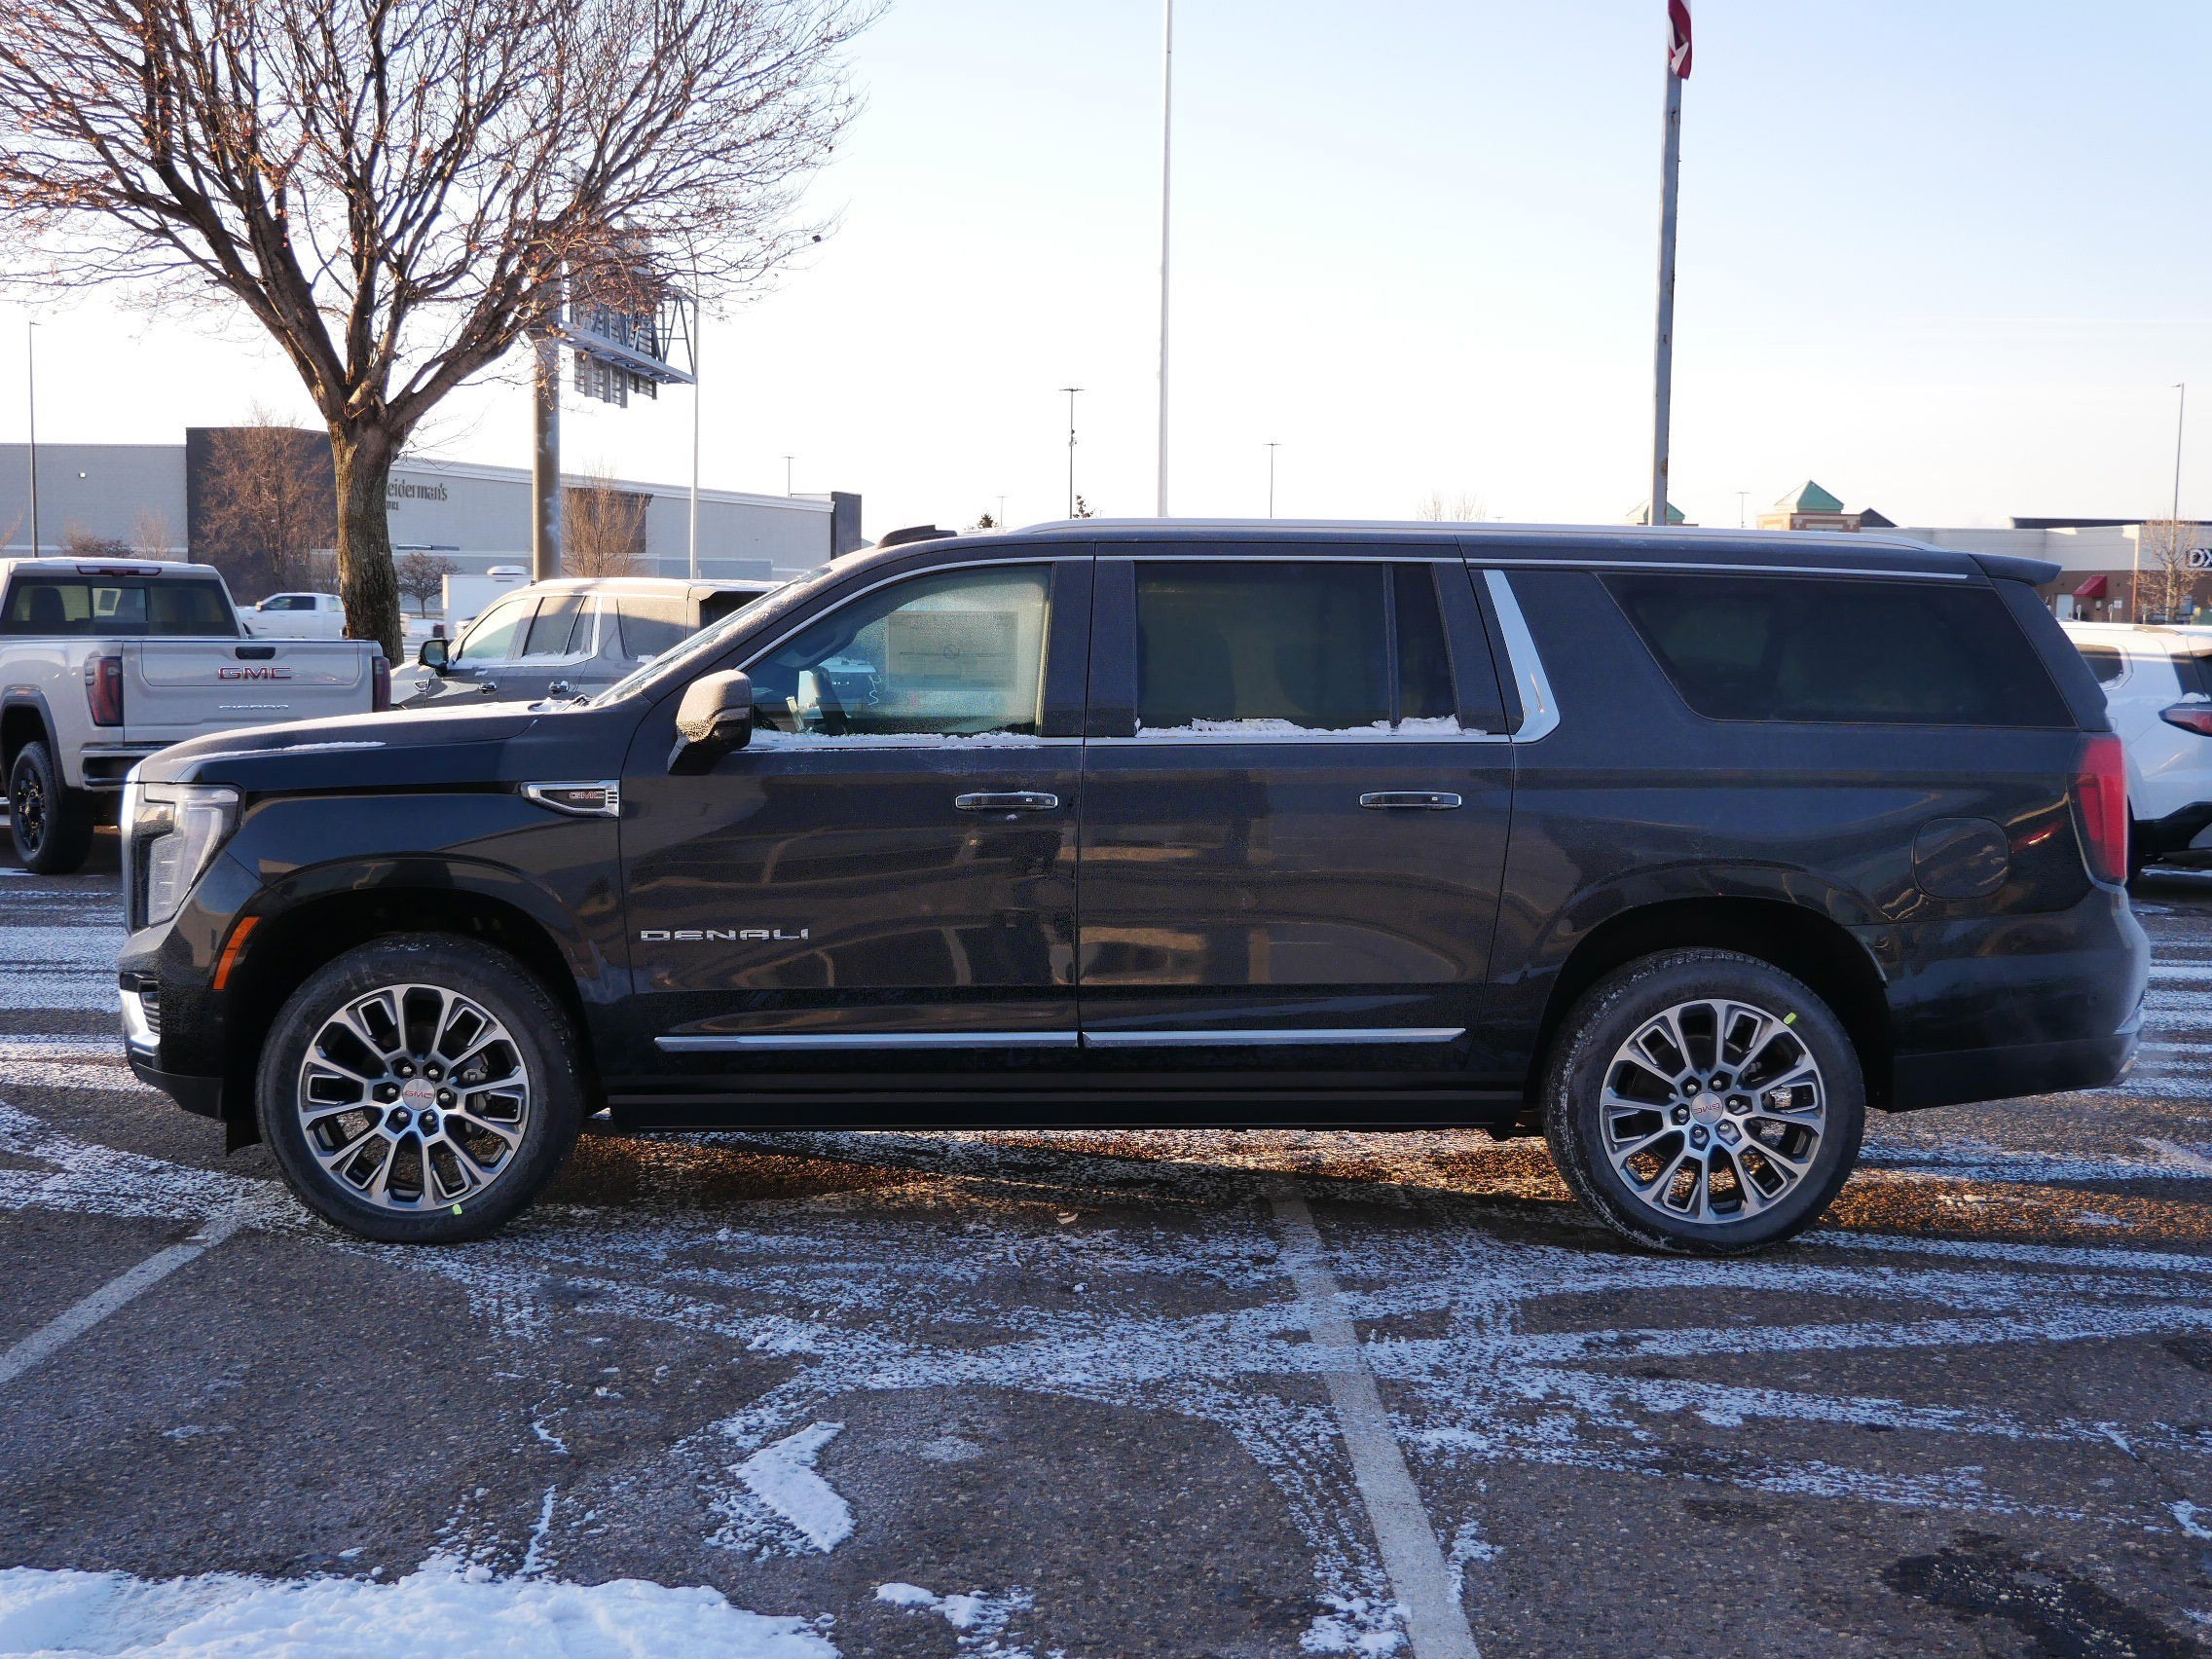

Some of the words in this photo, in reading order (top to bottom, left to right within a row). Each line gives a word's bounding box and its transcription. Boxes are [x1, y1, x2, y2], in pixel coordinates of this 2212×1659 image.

[218, 666, 292, 680] GMC
[641, 929, 809, 941] DENALI
[404, 1090, 432, 1099] GMC
[1694, 1102, 1720, 1115] GMC
